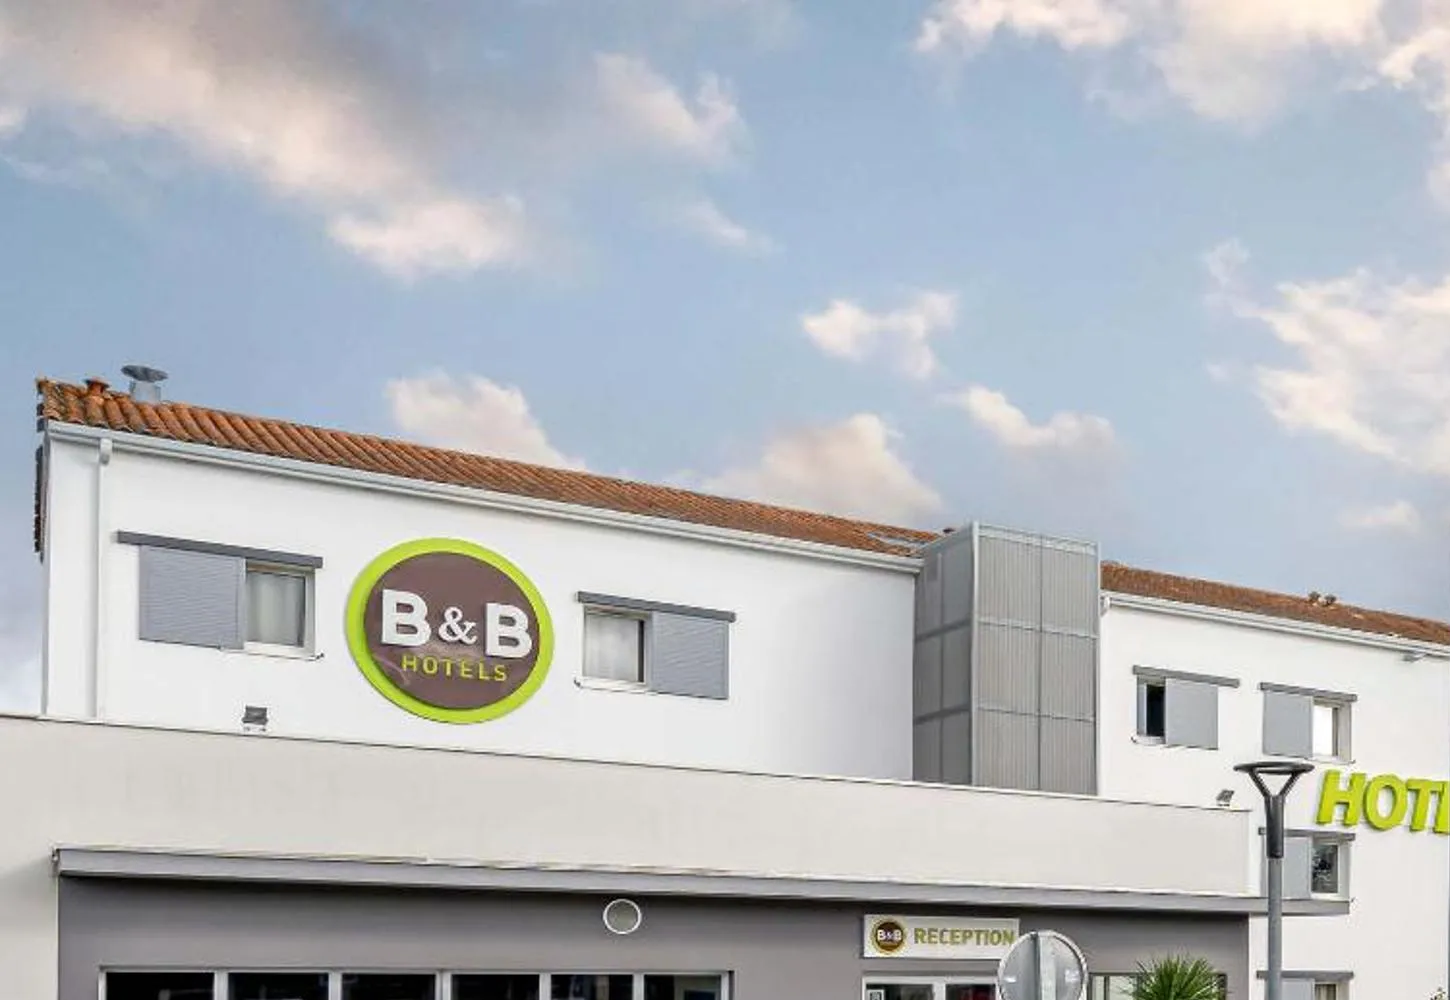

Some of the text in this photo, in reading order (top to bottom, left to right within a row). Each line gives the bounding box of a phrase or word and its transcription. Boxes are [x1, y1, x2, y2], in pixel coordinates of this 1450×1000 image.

[380, 588, 533, 658] B&B
[401, 655, 508, 682] HOTELS
[914, 928, 1014, 946] RECEPTION
